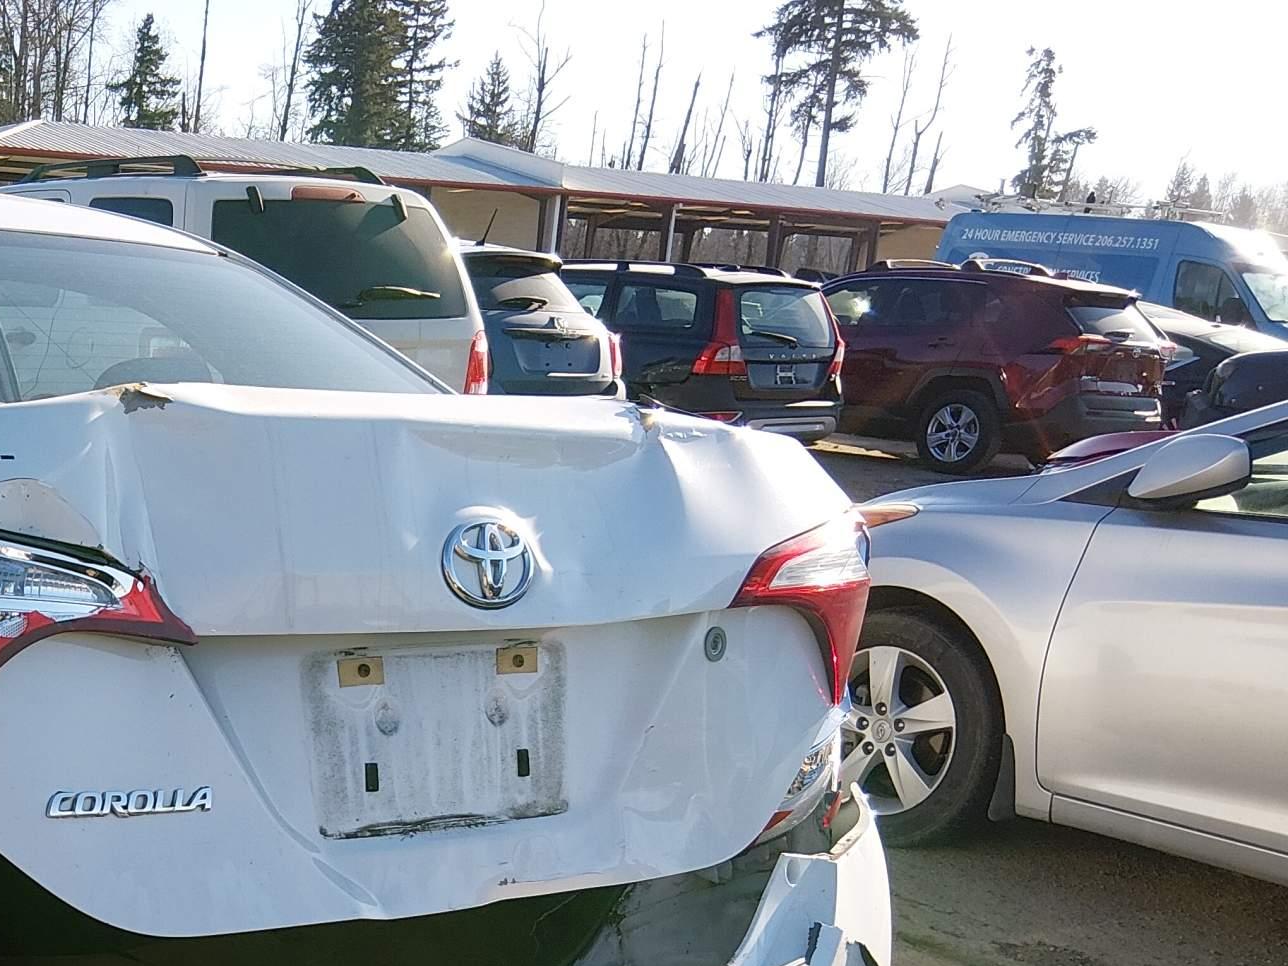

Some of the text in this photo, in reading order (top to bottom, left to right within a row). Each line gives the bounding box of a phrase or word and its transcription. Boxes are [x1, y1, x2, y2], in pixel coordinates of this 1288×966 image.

[962, 228, 1159, 250] 24 HOUR EMERGENCY SERVICE 206.257.1351
[46, 786, 213, 818] COROLLA
